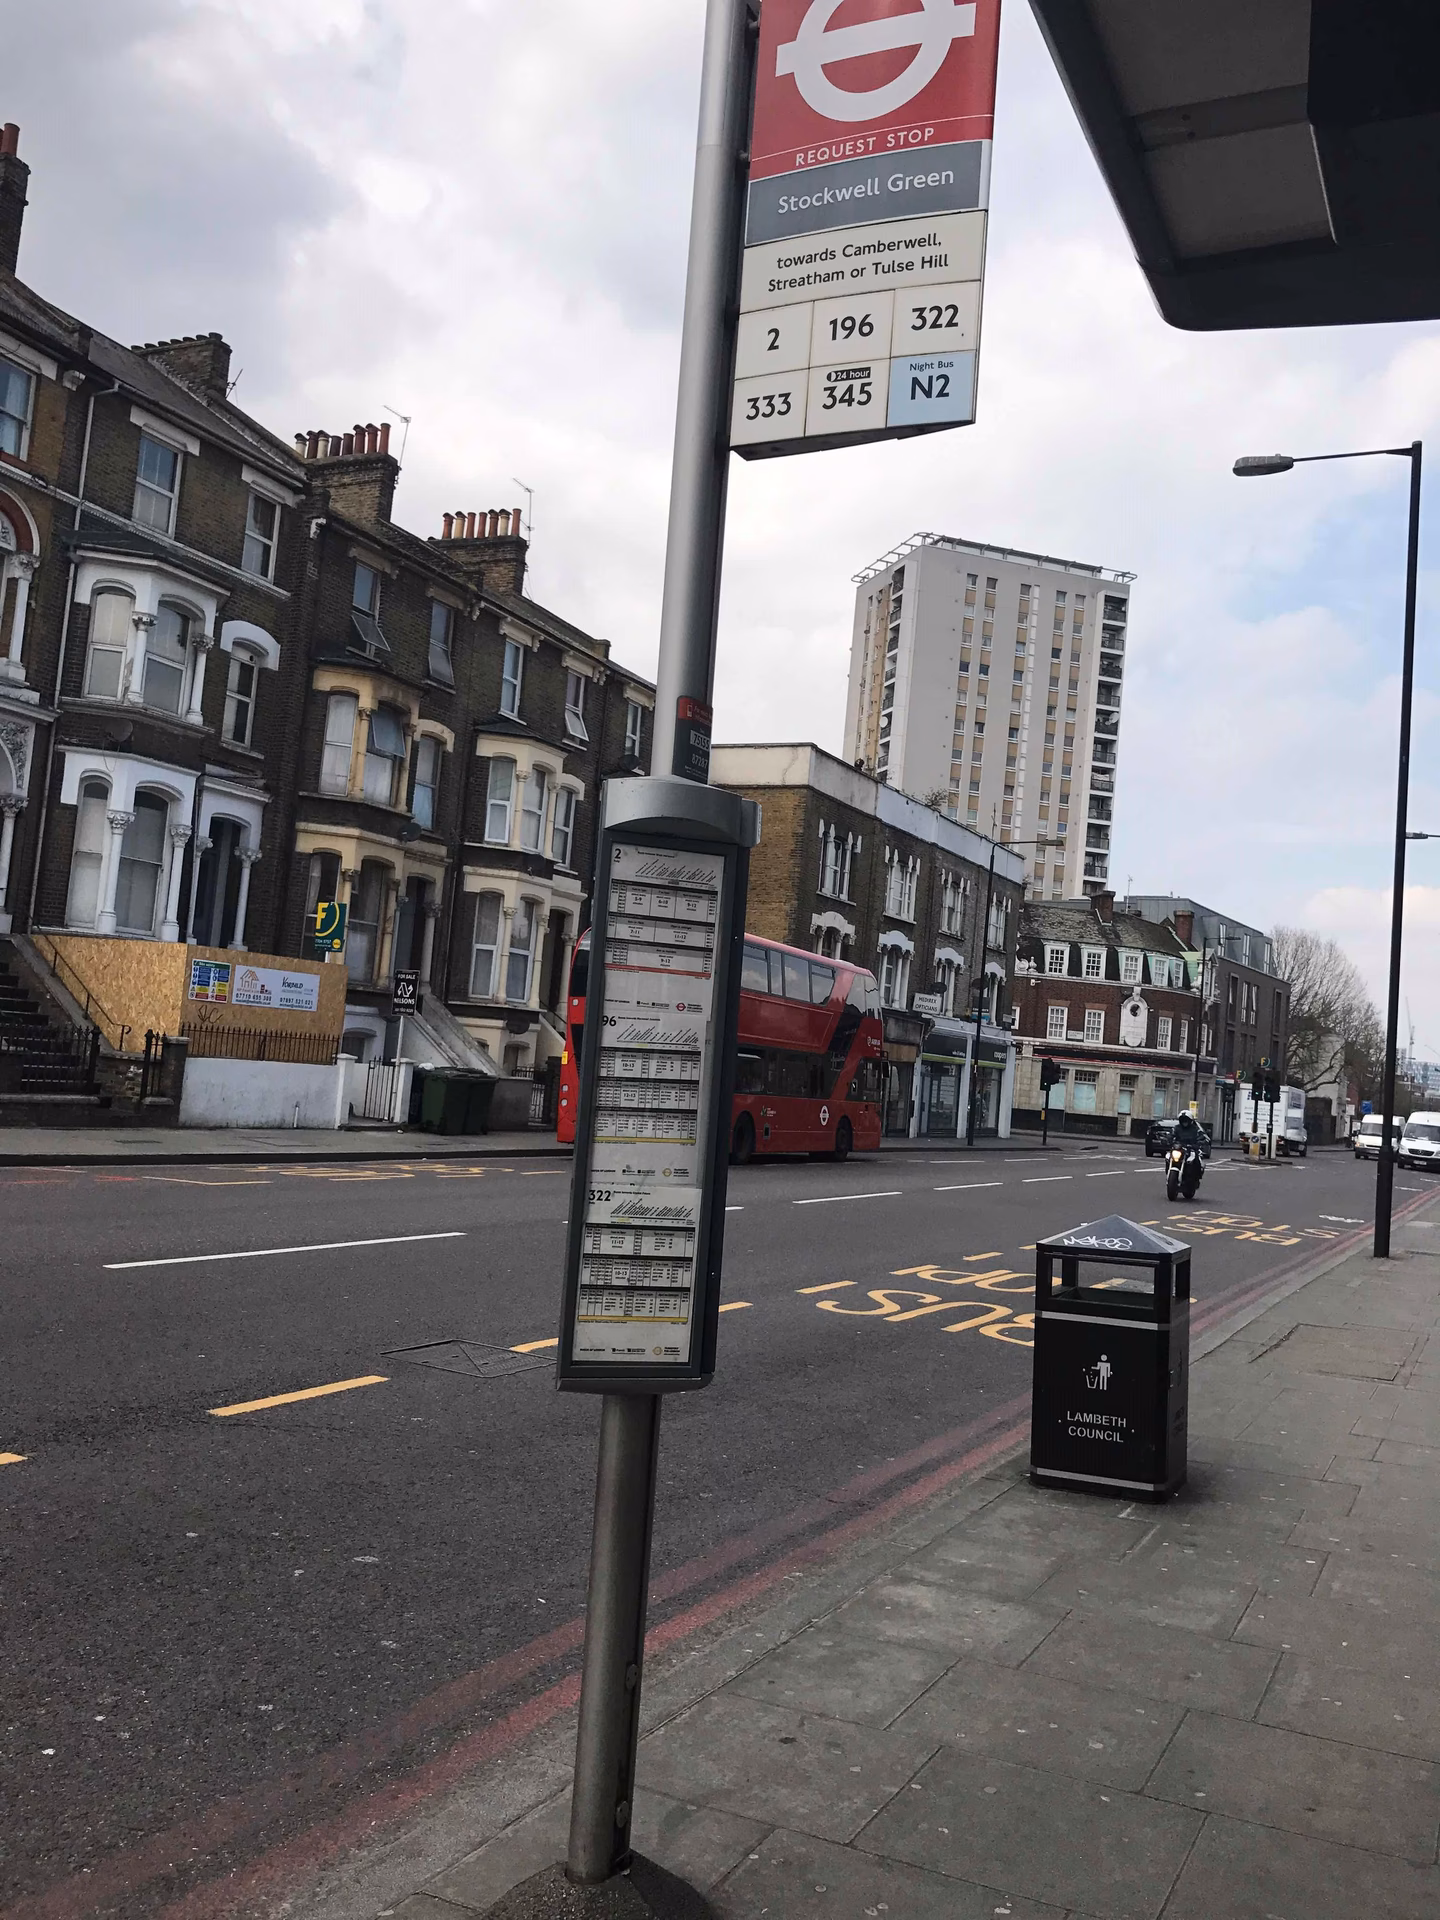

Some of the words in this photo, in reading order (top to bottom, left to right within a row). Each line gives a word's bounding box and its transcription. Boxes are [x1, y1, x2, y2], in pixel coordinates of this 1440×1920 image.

[795, 136, 878, 166] REQUEST
[886, 127, 935, 149] STOP
[777, 177, 880, 214] Stockwell
[887, 170, 955, 194] Green
[777, 247, 837, 270] towards
[842, 232, 943, 259] Camberwell,
[768, 268, 845, 293] Streatham
[850, 265, 867, 279] or
[872, 259, 915, 277] Tulse
[920, 254, 949, 270] Hill
[829, 313, 875, 342] 196
[910, 304, 960, 331] 322
[767, 328, 780, 352] 2
[836, 371, 847, 380] 24
[849, 369, 870, 379] hour
[909, 360, 935, 373] Night
[937, 358, 955, 370] Bus
[822, 381, 873, 410] 345
[909, 374, 950, 401] N2
[746, 393, 792, 421] 333
[614, 848, 622, 859] 2
[316, 902, 329, 930] F
[915, 1003, 938, 1012] OPTICIANS
[918, 996, 937, 1004] MEDIREX
[602, 1015, 617, 1026] 96
[588, 1189, 611, 1202] 322
[1066, 1410, 1127, 1428] LAMBETH
[1068, 1425, 1124, 1443] COUNCIL
